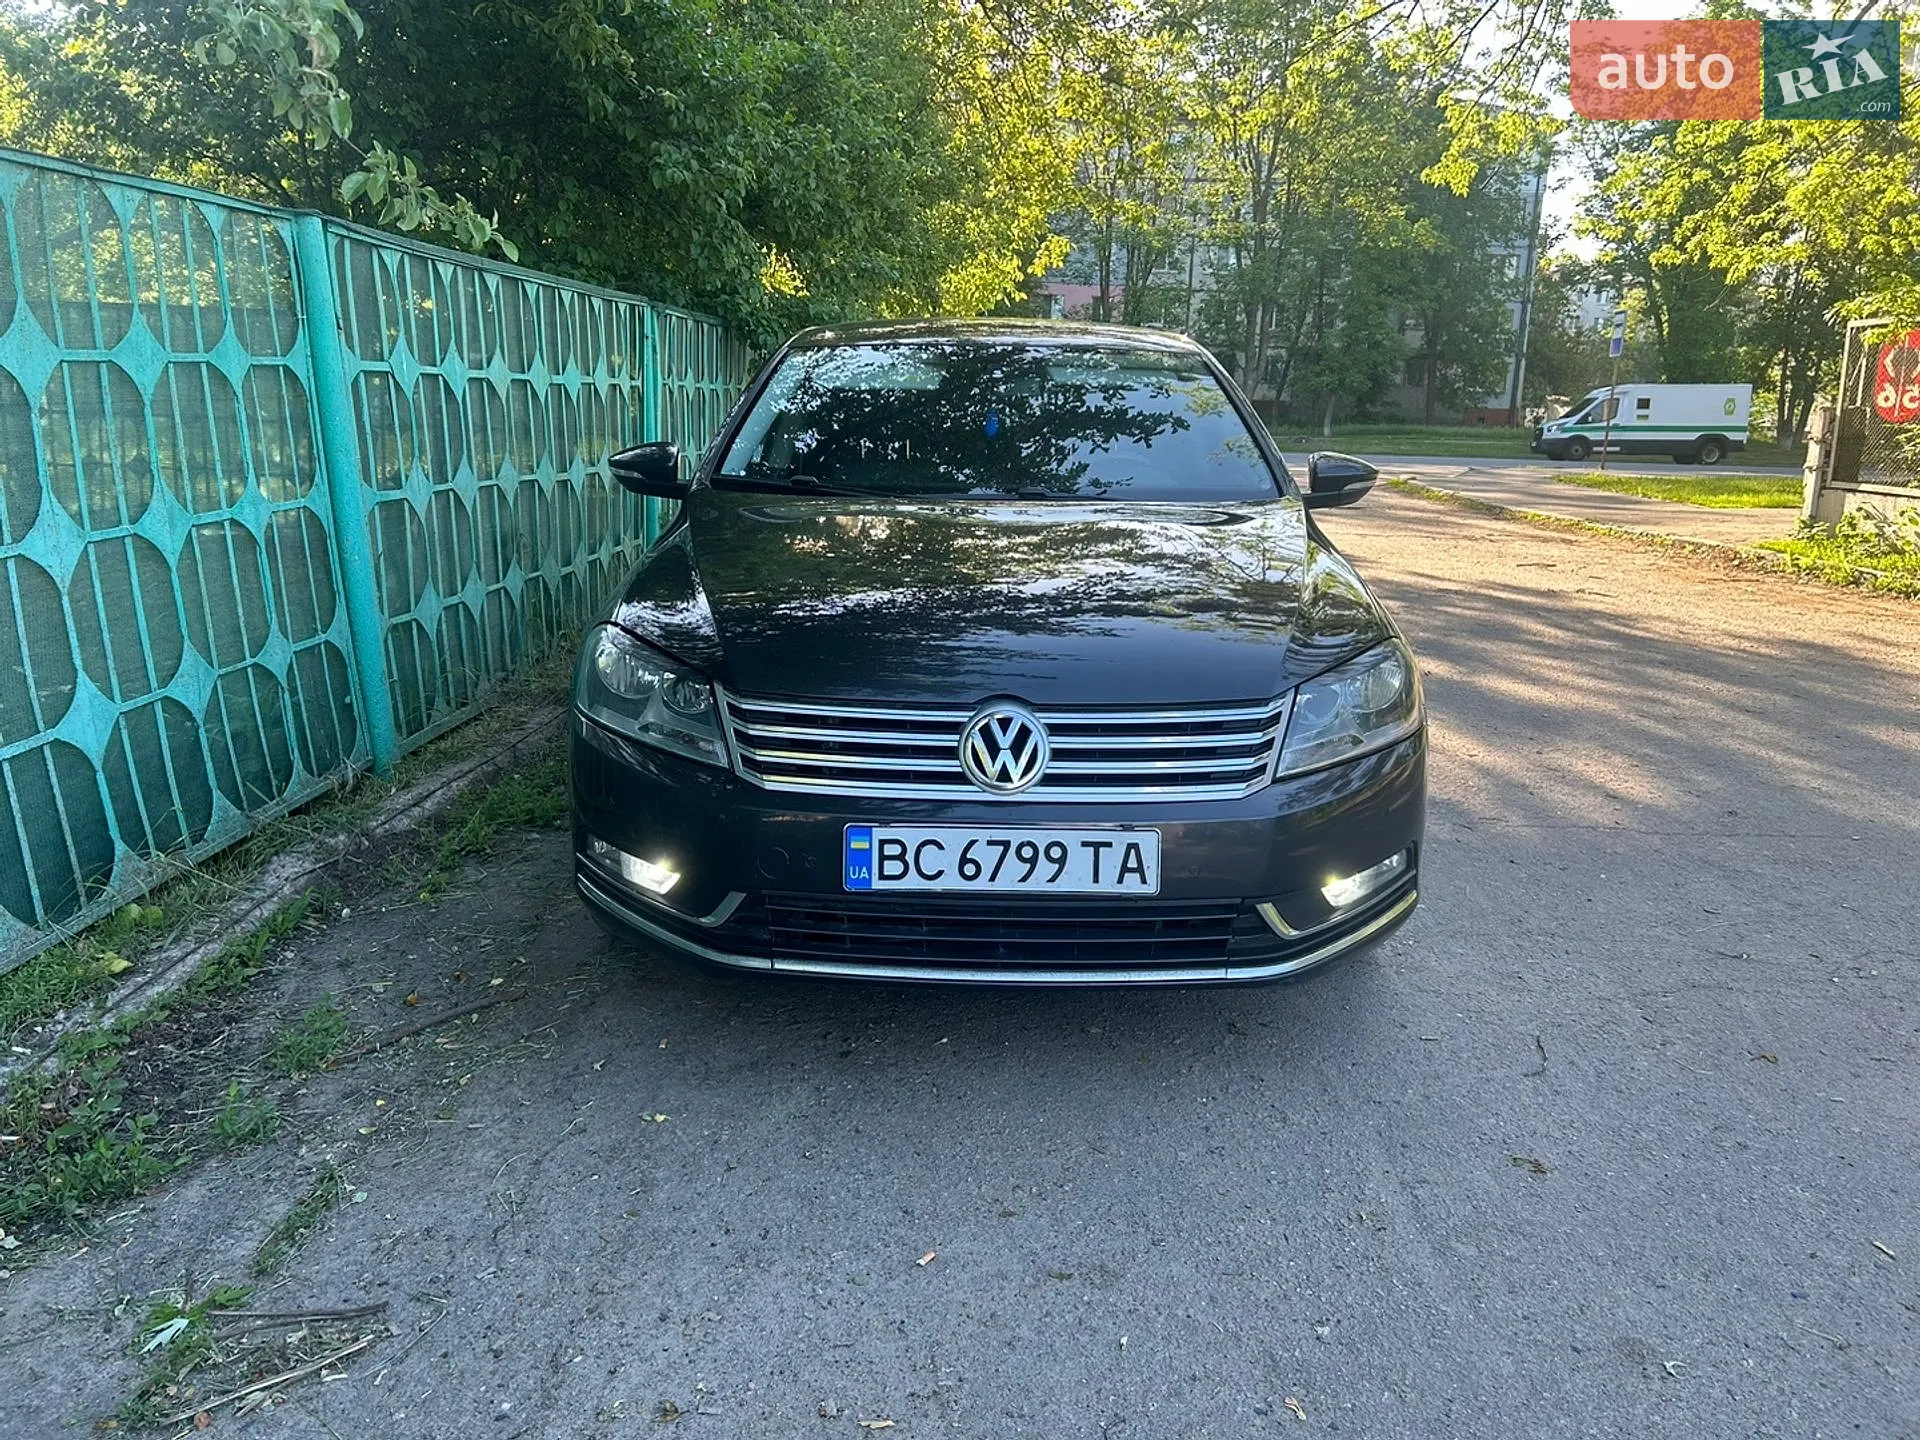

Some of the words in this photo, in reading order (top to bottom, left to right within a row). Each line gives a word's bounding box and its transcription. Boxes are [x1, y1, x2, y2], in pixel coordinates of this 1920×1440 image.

[850, 866, 869, 879] UA
[877, 838, 945, 881] BC
[957, 839, 1069, 883] 6799
[1080, 841, 1148, 885] TA
